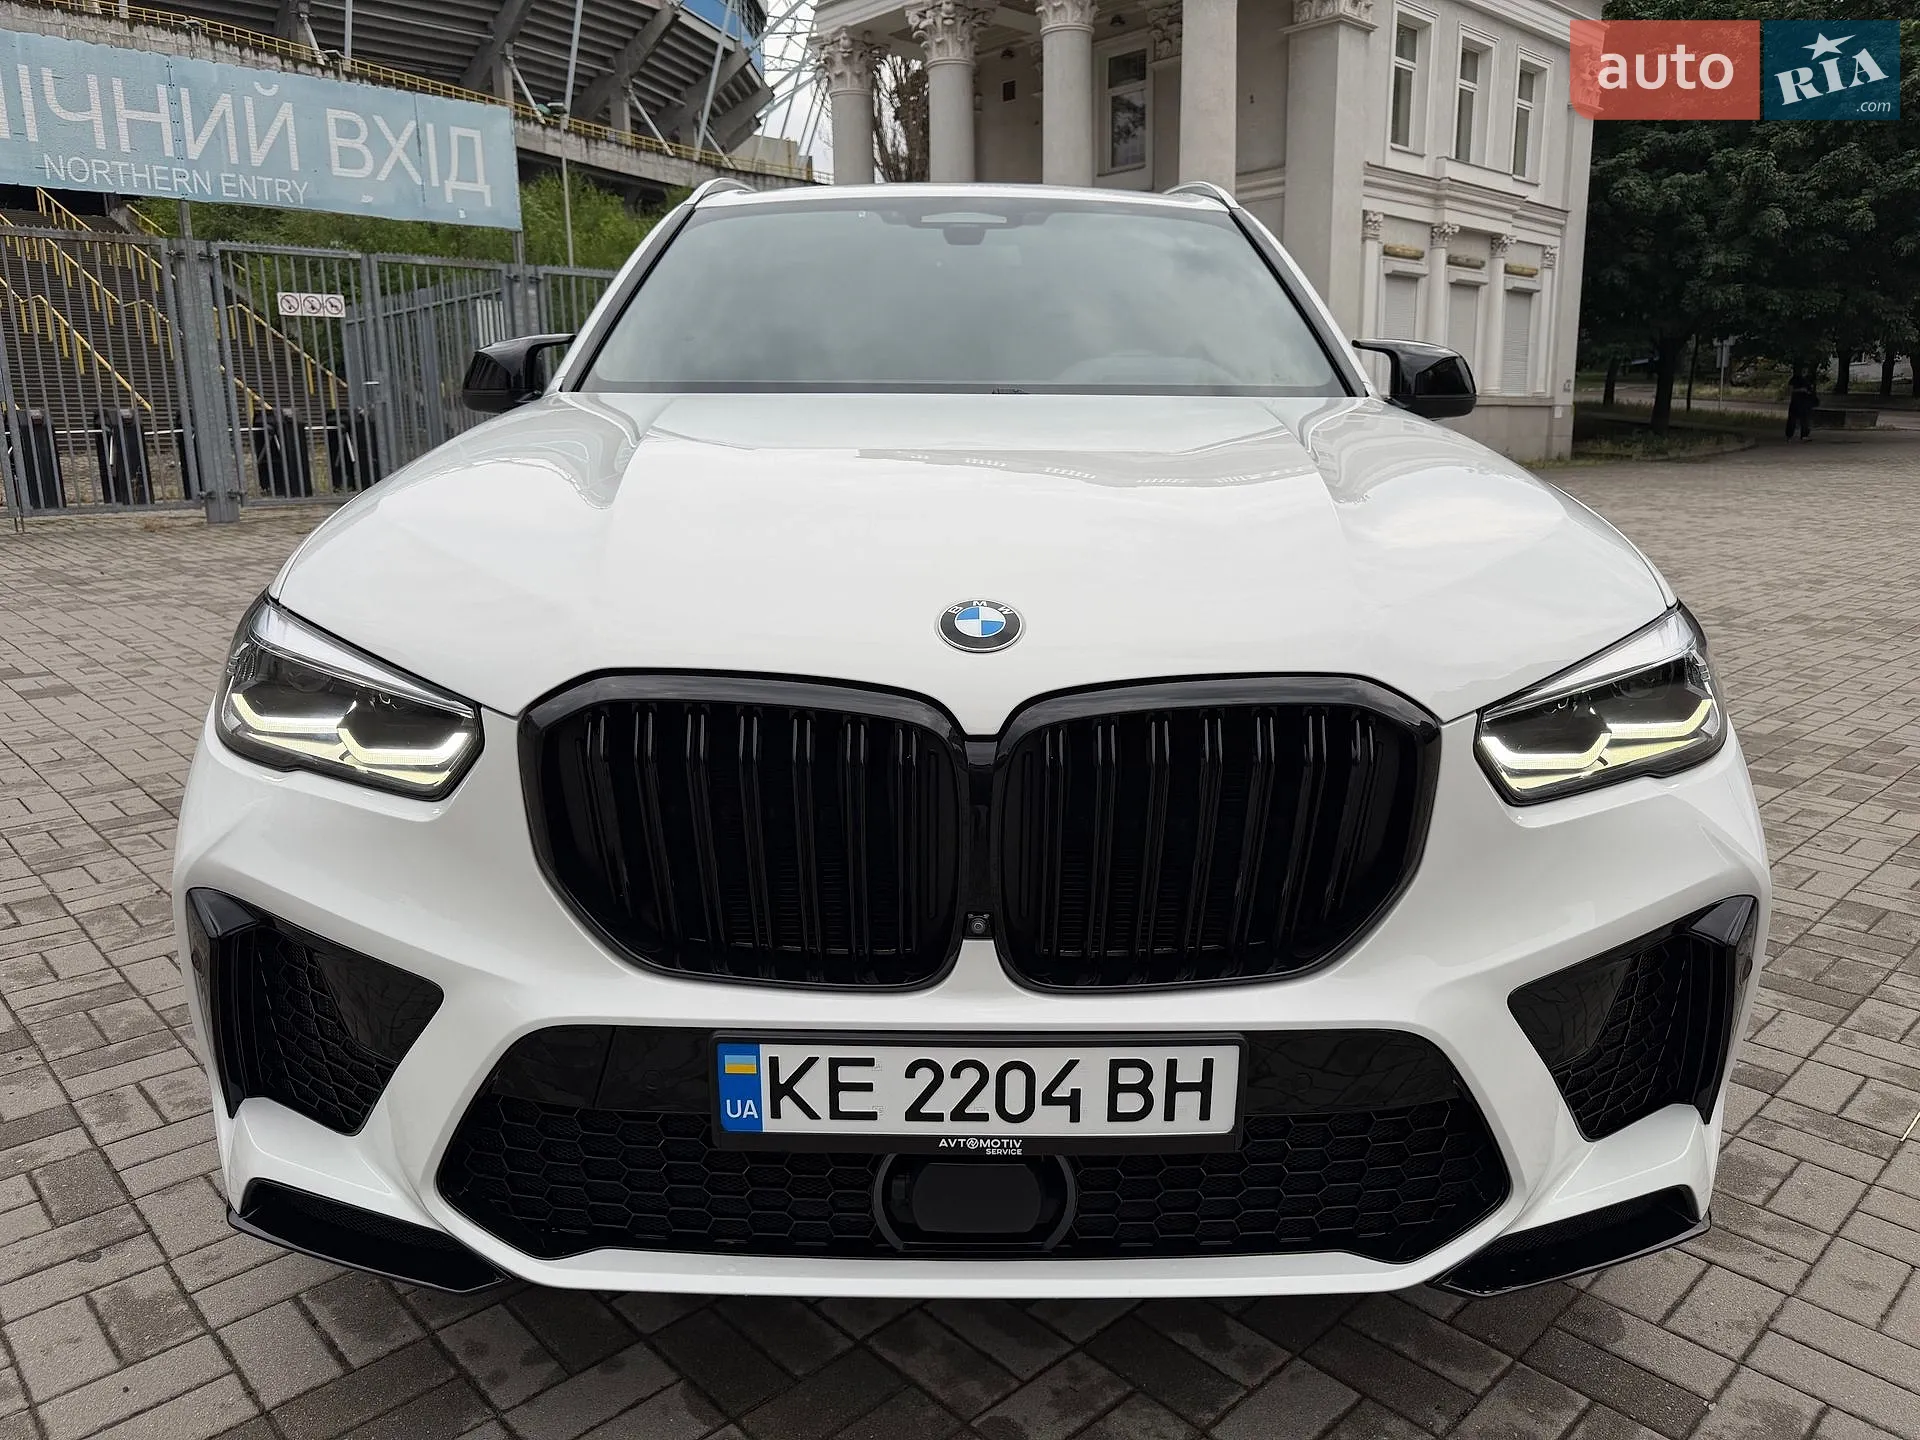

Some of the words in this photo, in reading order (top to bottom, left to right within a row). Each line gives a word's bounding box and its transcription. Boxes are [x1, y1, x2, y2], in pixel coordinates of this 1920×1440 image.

[326, 107, 492, 207] ВХІД
[43, 153, 213, 196] NORTHERN
[220, 173, 309, 205] ENTRY
[948, 600, 1014, 615] BMW
[769, 1055, 877, 1121] KE
[904, 1058, 1082, 1123] 2204
[1107, 1057, 1215, 1122] BH
[725, 1099, 759, 1120] UA
[985, 1148, 1023, 1156] SERVICE
